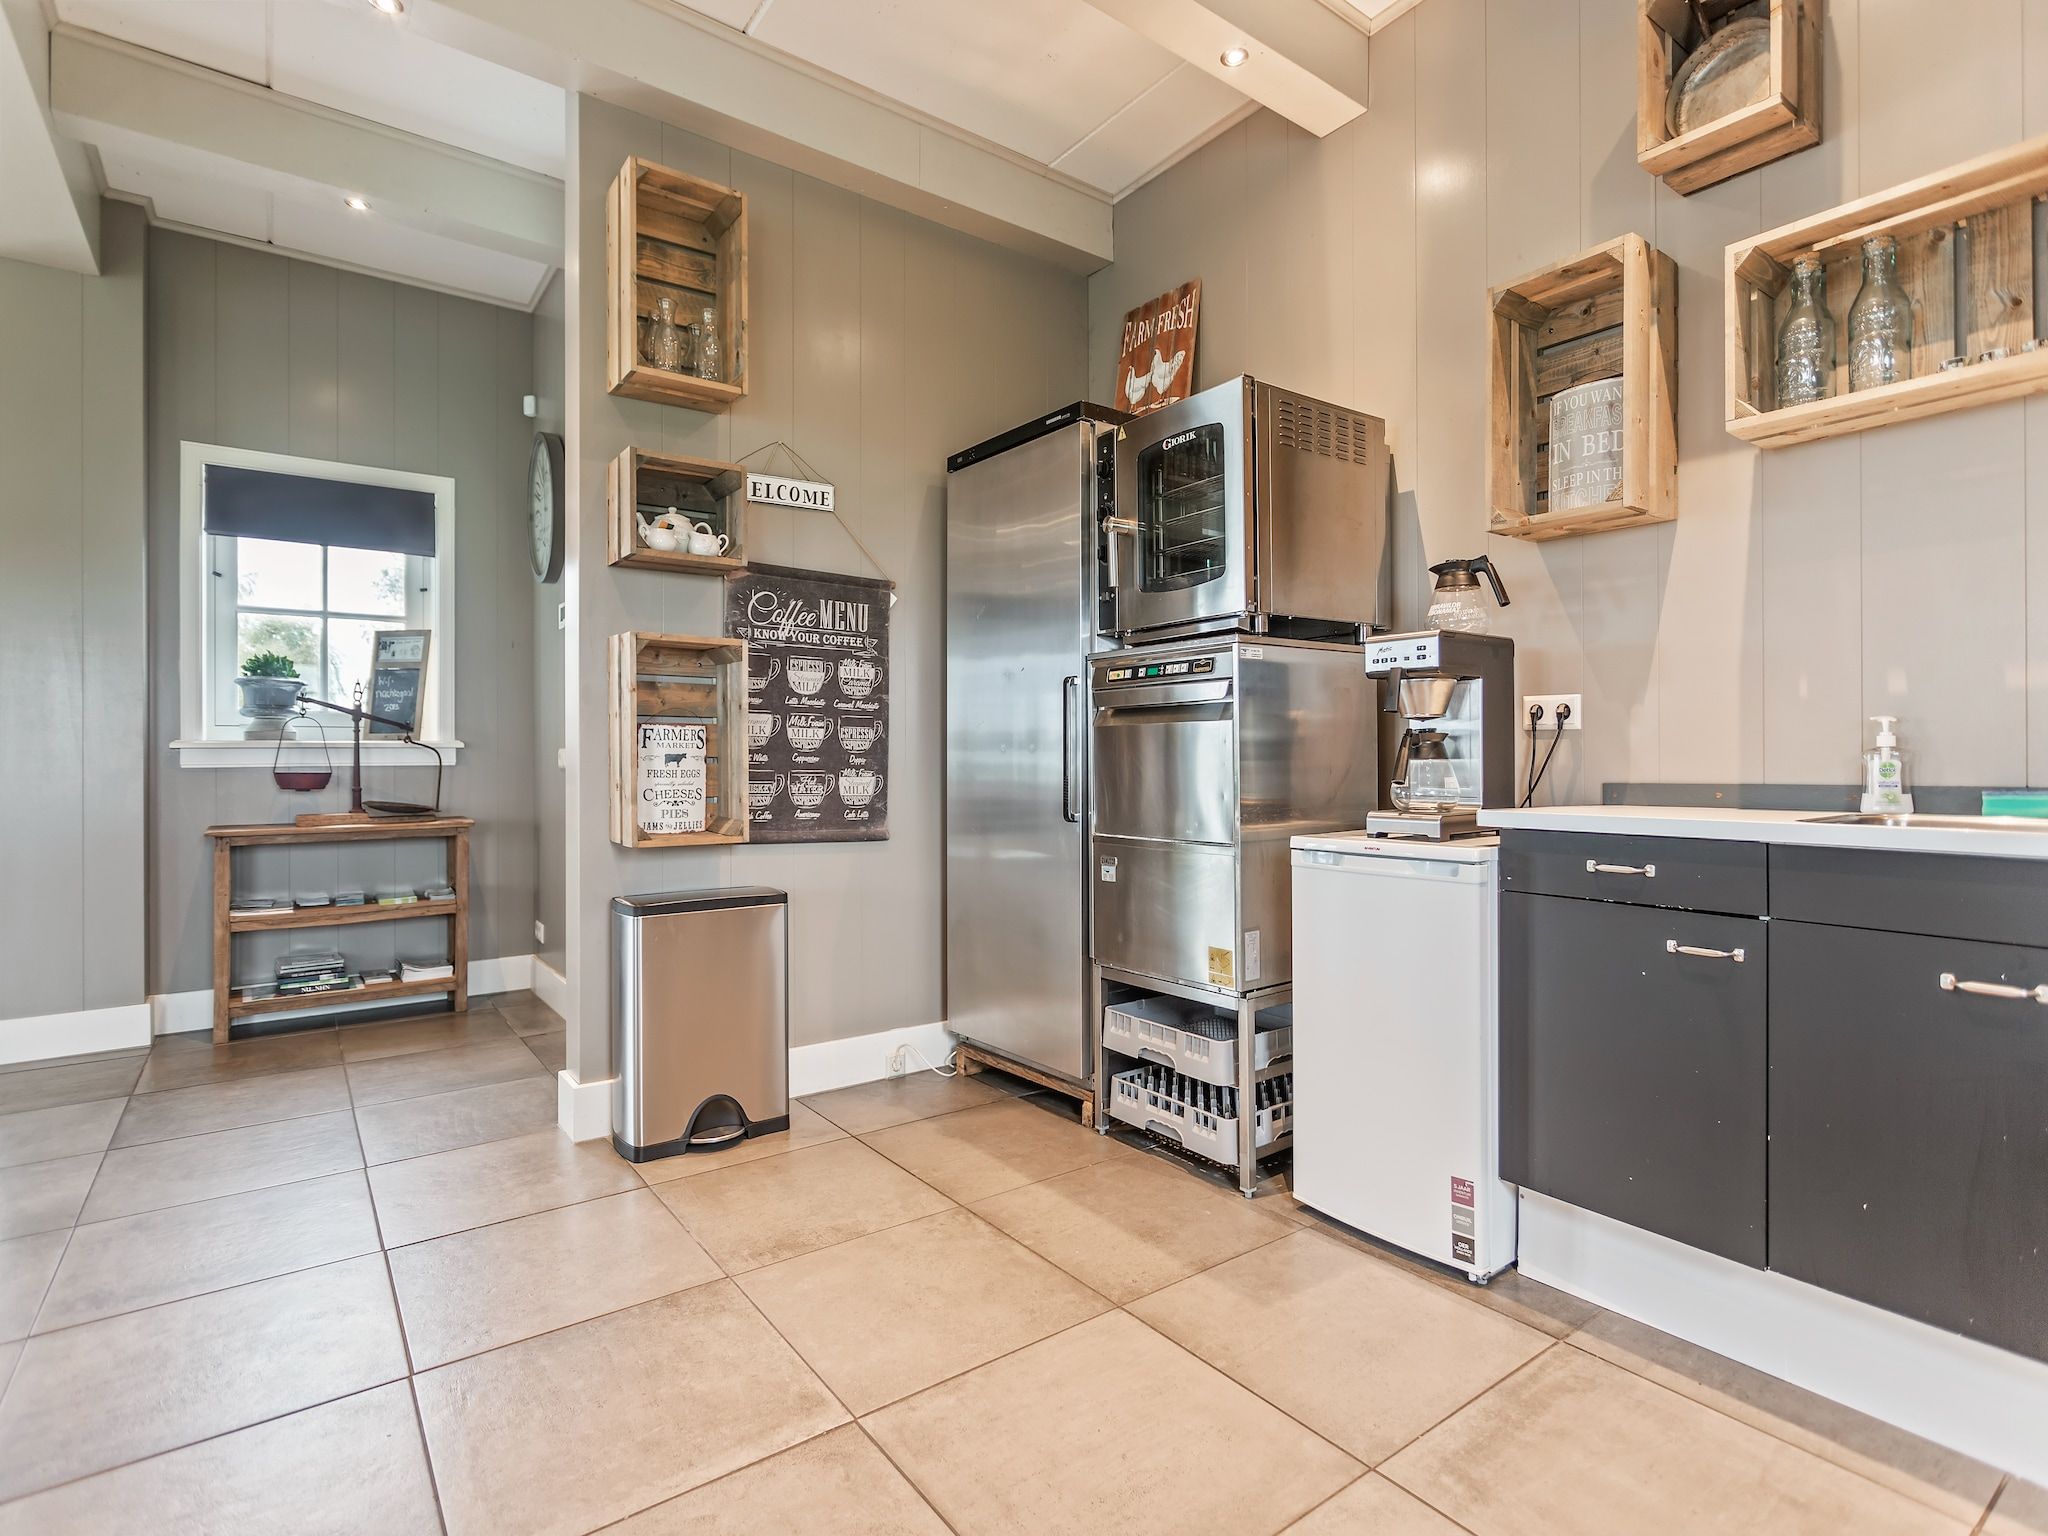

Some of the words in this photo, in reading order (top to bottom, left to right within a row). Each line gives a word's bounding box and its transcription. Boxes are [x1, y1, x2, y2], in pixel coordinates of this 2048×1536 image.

[1122, 317, 1155, 358] FARM
[1157, 288, 1197, 335] FRESH
[1553, 401, 1563, 416] IF
[1564, 393, 1587, 411] YOU
[1590, 386, 1623, 404] WAN
[1552, 404, 1623, 441] BREAKFAS
[1162, 430, 1196, 450] GIORIK
[1553, 440, 1572, 465] IN
[1552, 472, 1584, 492] SLEEP
[1586, 469, 1601, 484] IN
[1603, 466, 1623, 481] TH
[748, 481, 830, 507] ELCOME
[748, 588, 816, 637] Coffee
[819, 599, 869, 632] MENU
[753, 628, 787, 641] KNOW
[791, 631, 820, 644] YOUR
[823, 634, 864, 647] COFFEE
[641, 728, 705, 749] FARMERS
[647, 769, 678, 778] FRESH
[680, 770, 701, 778] EGGS
[643, 787, 703, 801] CHEESES
[661, 809, 689, 818] PIES
[643, 822, 664, 830] JAMS
[673, 821, 702, 830] JELLIES
